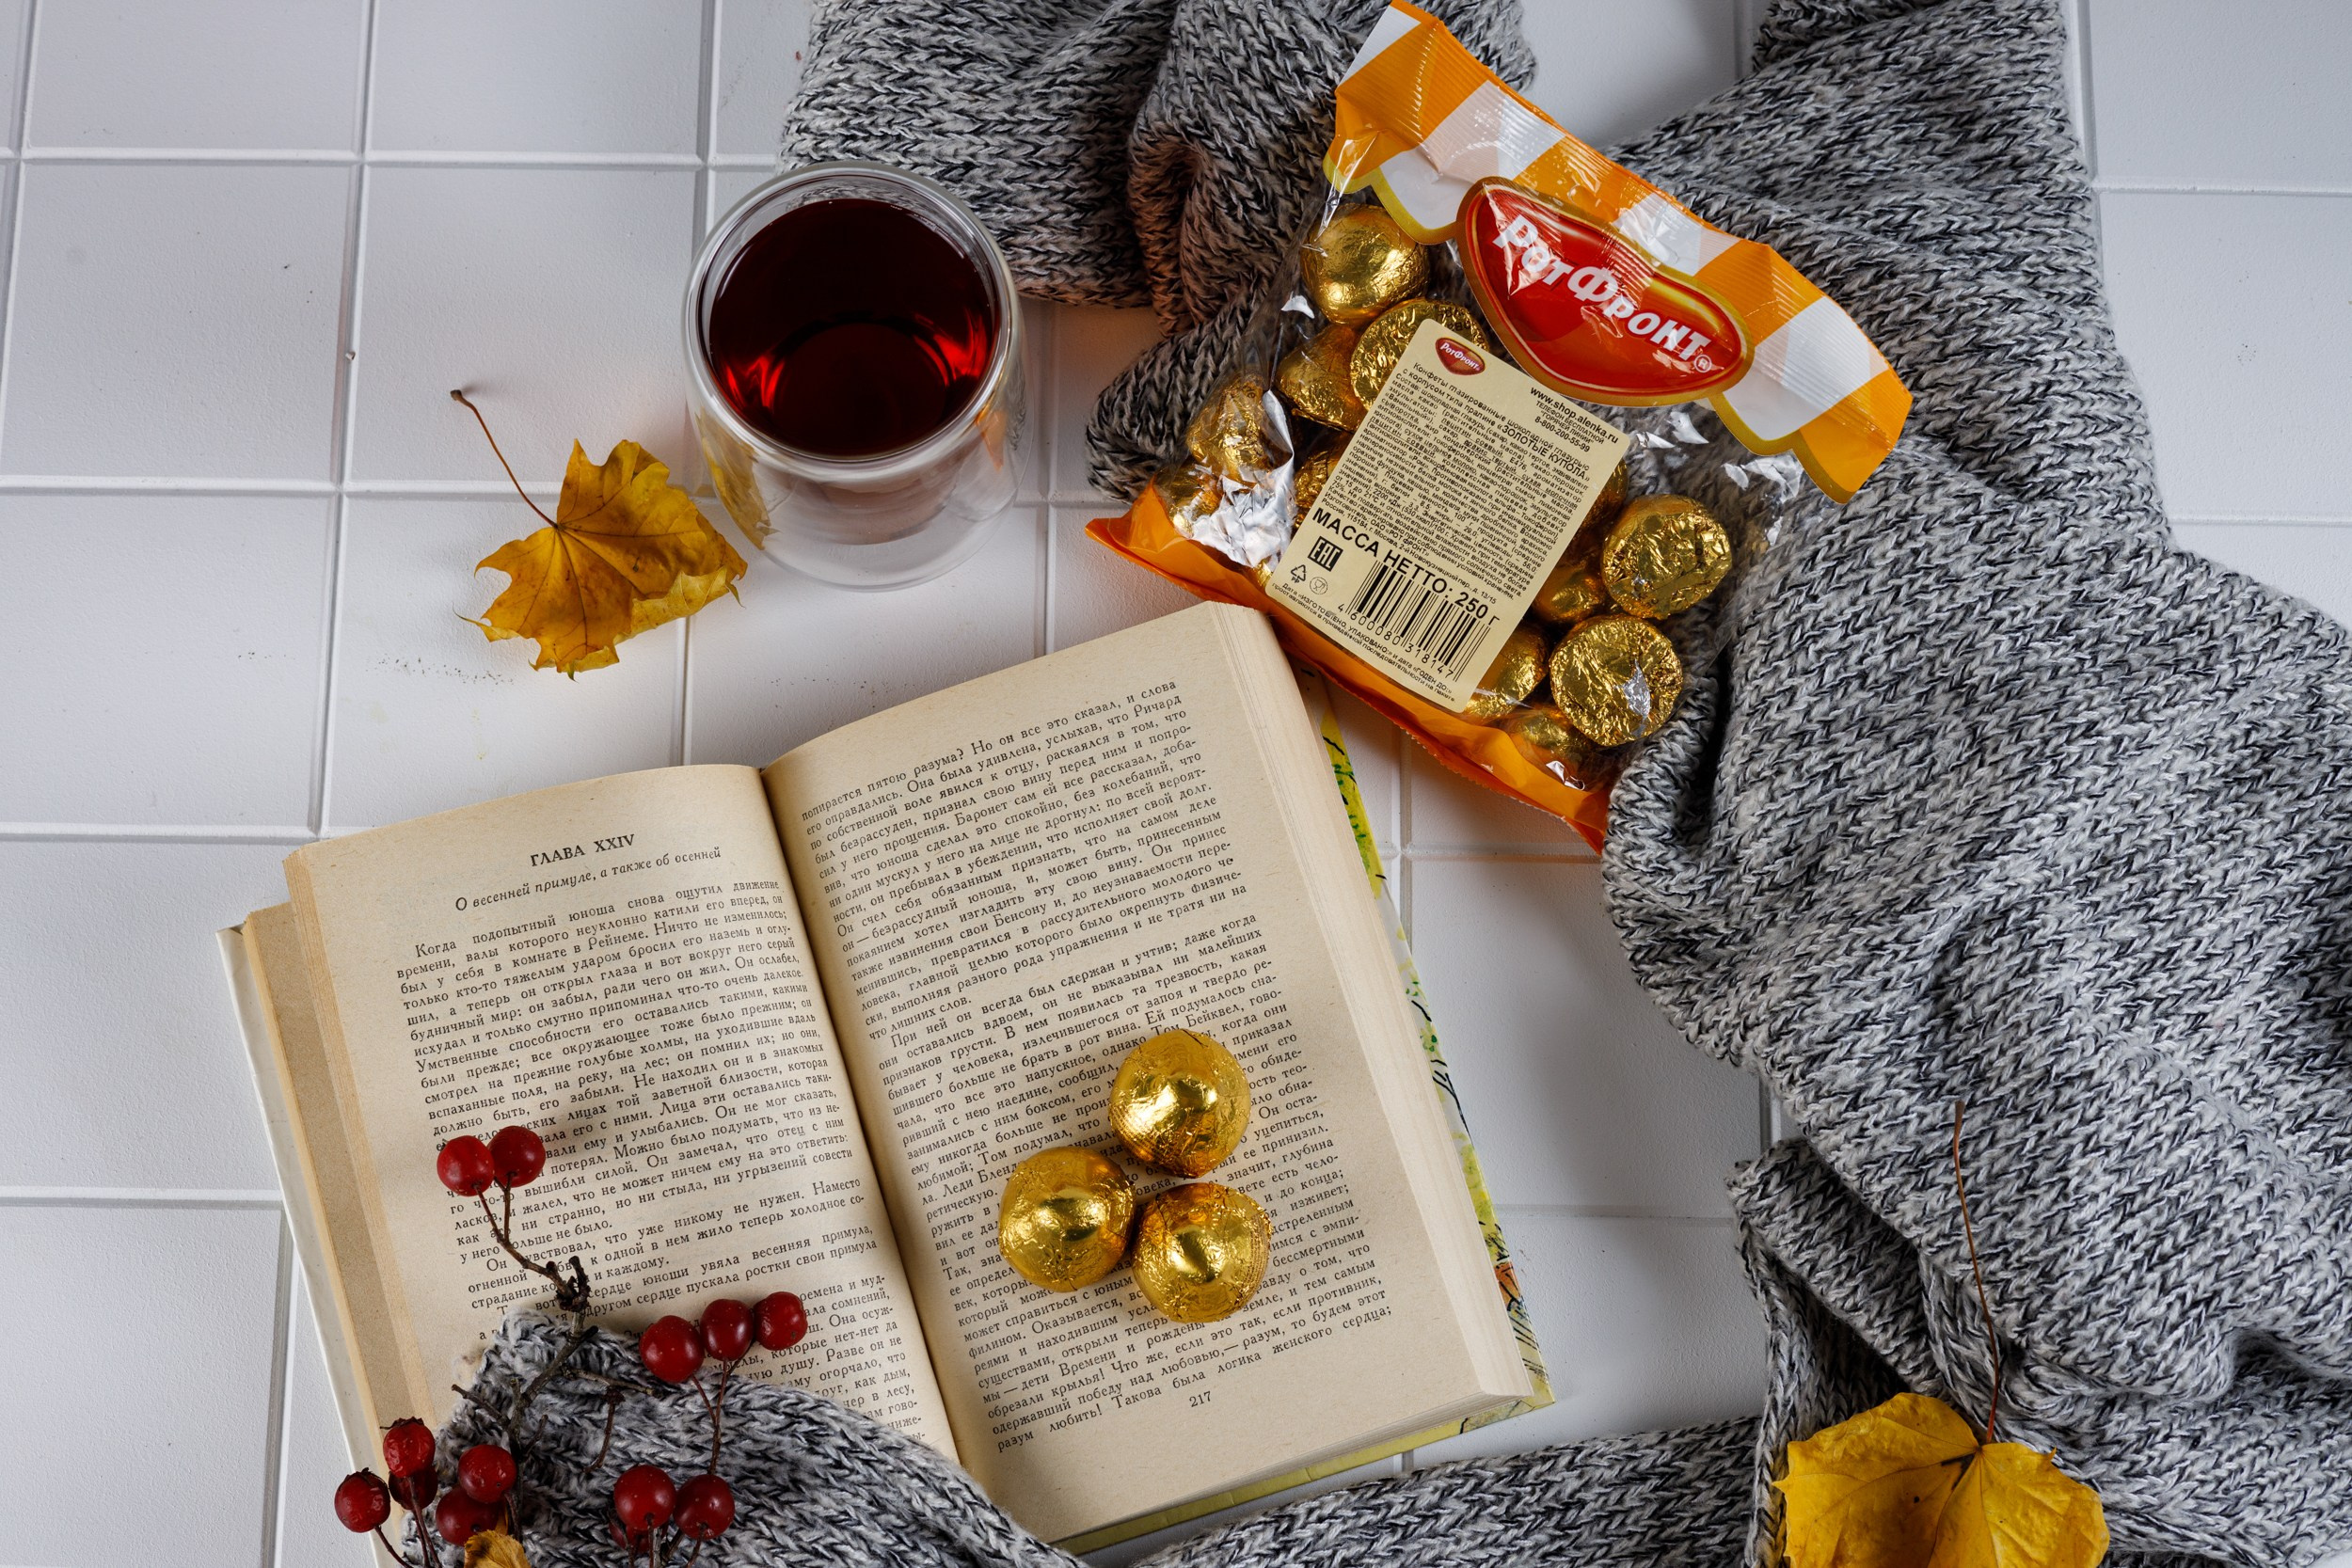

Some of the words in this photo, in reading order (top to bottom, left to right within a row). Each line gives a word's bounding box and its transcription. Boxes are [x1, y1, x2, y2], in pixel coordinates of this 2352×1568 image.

[1407, 372, 1446, 397] корпусом
[1445, 392, 1464, 408] типа
[1463, 404, 1496, 427] пралине
[1496, 423, 1549, 457] «ЗОЛОТЫЕ
[1548, 451, 1591, 483] КУПОЛА»
[1412, 361, 1449, 388] Конфеты
[1448, 384, 1506, 422] глазированные
[1505, 419, 1554, 450] шоколадной
[1553, 446, 1590, 471] глазурью
[1530, 387, 1619, 444] www.shop.alenka.ru
[1534, 416, 1591, 452] 8-800-200-55-99
[1535, 400, 1565, 420] ТЕЛЕФОН
[1563, 417, 1605, 445] БЕСПЛАТНОЙ
[1321, 497, 1345, 517] Россия,
[1373, 529, 1398, 548] Москва,
[1370, 518, 1386, 531] ОАО
[1311, 506, 1379, 558] МАССА
[1382, 548, 1454, 599] НЕТТО:
[1454, 591, 1489, 619] 250
[1487, 614, 1501, 626] г
[1338, 602, 1347, 614] 4
[1349, 611, 1401, 647] 600080
[1405, 642, 1455, 679] 318147
[801, 787, 863, 821] попирается
[866, 772, 907, 793] пятою
[914, 747, 964, 779] разума?
[970, 739, 993, 755] Но
[998, 734, 1015, 746] он
[1020, 725, 1041, 739] все
[1046, 717, 1069, 730] это
[1074, 701, 1121, 721] сказал,
[1125, 694, 1136, 705] и
[1140, 681, 1177, 699] слова
[806, 822, 822, 836] его
[825, 791, 903, 826] оправдались.
[906, 778, 935, 793] Она
[939, 765, 974, 783] была
[977, 743, 1041, 772] удивлена,
[1044, 722, 1103, 750] услыхав,
[1106, 713, 1129, 726] что
[1133, 695, 1183, 718] Ричард
[454, 896, 468, 911] О
[472, 882, 531, 908] весенней
[534, 872, 596, 894] примуле,
[599, 869, 608, 879] а
[611, 860, 652, 876] также
[655, 852, 670, 867] об
[675, 846, 722, 863] осенней
[530, 844, 586, 867] ГЛАВА
[593, 833, 635, 853] XXIV
[396, 958, 455, 980] времени,
[465, 947, 500, 963] валы
[508, 931, 569, 952] которого
[575, 913, 647, 937] неуклонно
[653, 904, 700, 920] катили
[706, 900, 725, 911] его
[729, 895, 770, 908] вперед,
[771, 895, 784, 904] он
[400, 981, 428, 994] был
[437, 976, 444, 989] у
[454, 966, 485, 982] себя
[494, 962, 502, 973] в
[511, 948, 567, 968] комнате
[573, 944, 581, 954] в
[588, 930, 649, 951] Рейнеме.
[653, 920, 698, 937] Ничто
[704, 917, 719, 927] не
[723, 911, 787, 924] изменилось;
[415, 941, 457, 958] Когда
[471, 913, 557, 944] подопытный
[568, 904, 616, 923] юноша
[627, 895, 665, 910] снова
[675, 885, 723, 901] ощутил
[733, 880, 780, 893] движение
[403, 992, 450, 1010] только
[455, 980, 498, 998] кто-то
[503, 964, 565, 987] тяжелым
[572, 951, 622, 974] ударом
[628, 941, 676, 959] бросил
[682, 936, 703, 947] его
[708, 928, 751, 942] наземь
[755, 927, 763, 935] и
[767, 925, 791, 936] оглу-
[890, 1032, 918, 1049] При
[925, 1017, 948, 1035] ней
[956, 1011, 973, 1023] он
[980, 994, 1024, 1015] всегда
[1028, 984, 1056, 999] был
[1059, 962, 1116, 988] сдержан
[1120, 958, 1130, 968] и
[1134, 942, 1178, 965] учтив;
[1184, 928, 1216, 947] даже
[1220, 914, 1257, 933] когда
[415, 1047, 499, 1073] Умственные
[508, 1024, 592, 1052] способности
[597, 1018, 624, 1030] его
[634, 999, 709, 1022] оставались
[718, 988, 768, 1004] такими,
[771, 984, 808, 995] какими
[636, 1287, 682, 1305] сердце
[686, 1273, 740, 1294] пускала
[745, 1259, 791, 1282] ростки
[795, 1251, 826, 1266] свои
[829, 1240, 878, 1259] примула
[992, 1397, 1072, 1435] одержавший
[1077, 1382, 1122, 1405] победу
[1129, 1371, 1154, 1387] над
[1242, 1326, 1286, 1351] разум,
[1290, 1319, 1307, 1330] то
[1311, 1302, 1352, 1323] будем
[1357, 1290, 1386, 1307] этот
[997, 1431, 1034, 1454] разум
[1049, 1402, 1103, 1433] любить!
[1110, 1386, 1163, 1409] Такова
[1171, 1370, 1207, 1389] была
[1217, 1352, 1263, 1374] логика
[1271, 1326, 1333, 1354] женского
[1342, 1306, 1391, 1329] сердца;
[1188, 1390, 1211, 1408] 217
